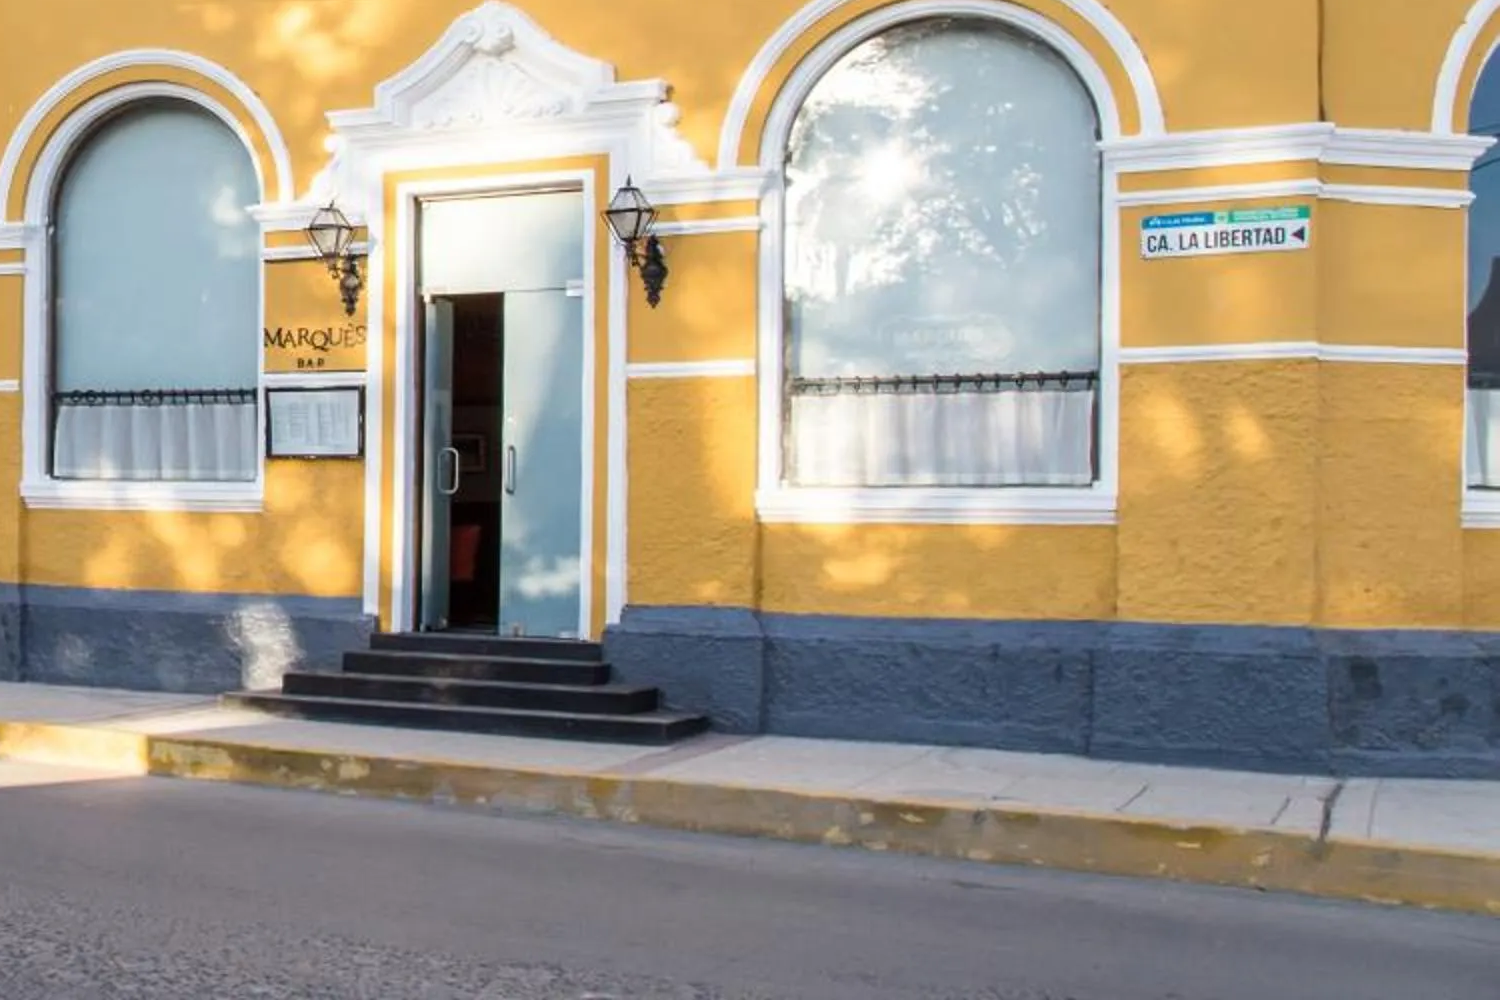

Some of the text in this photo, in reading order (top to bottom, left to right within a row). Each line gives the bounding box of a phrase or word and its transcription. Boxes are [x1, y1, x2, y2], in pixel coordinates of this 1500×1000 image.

[1147, 226, 1285, 253] CA. LA LIBERTAD
